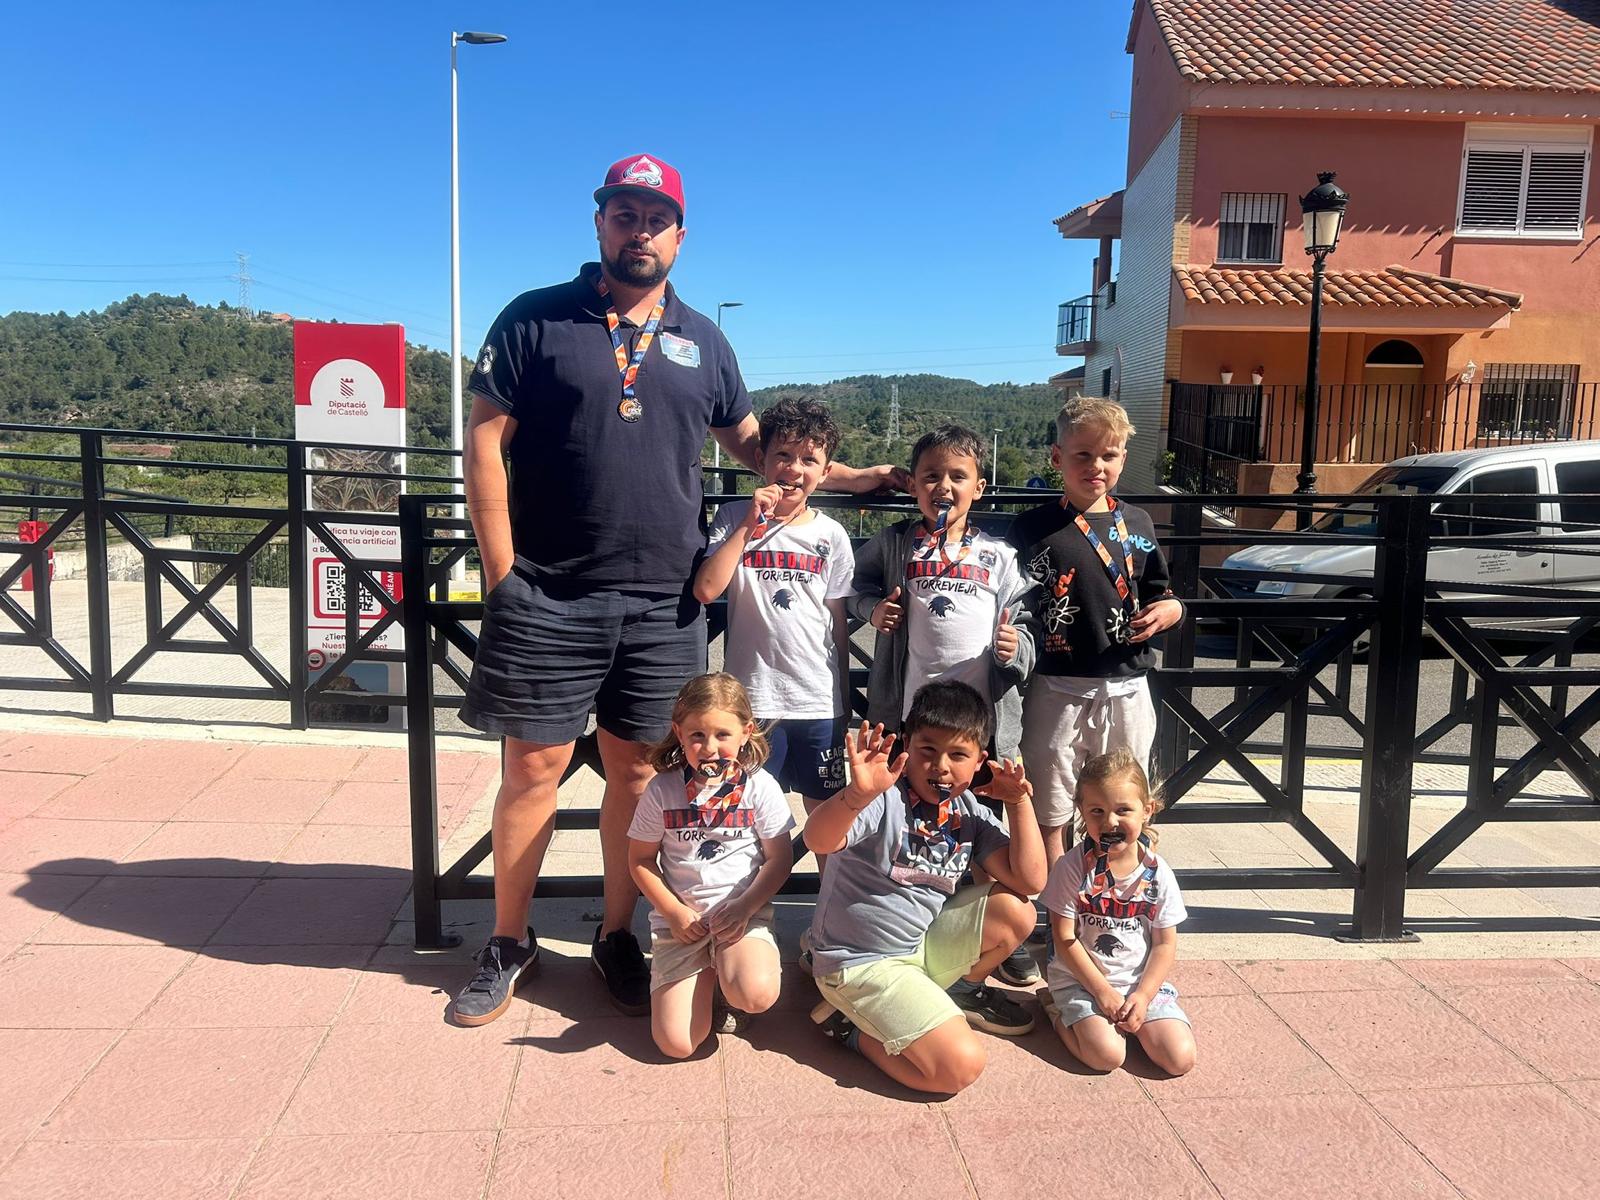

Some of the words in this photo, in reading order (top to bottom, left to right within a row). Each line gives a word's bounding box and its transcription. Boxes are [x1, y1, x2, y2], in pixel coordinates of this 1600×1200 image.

[328, 400, 367, 409] Diputació
[338, 408, 369, 417] Castelló
[360, 528, 380, 537] viaje
[362, 538, 397, 546] artificial
[916, 579, 978, 596] TORREVIEJA
